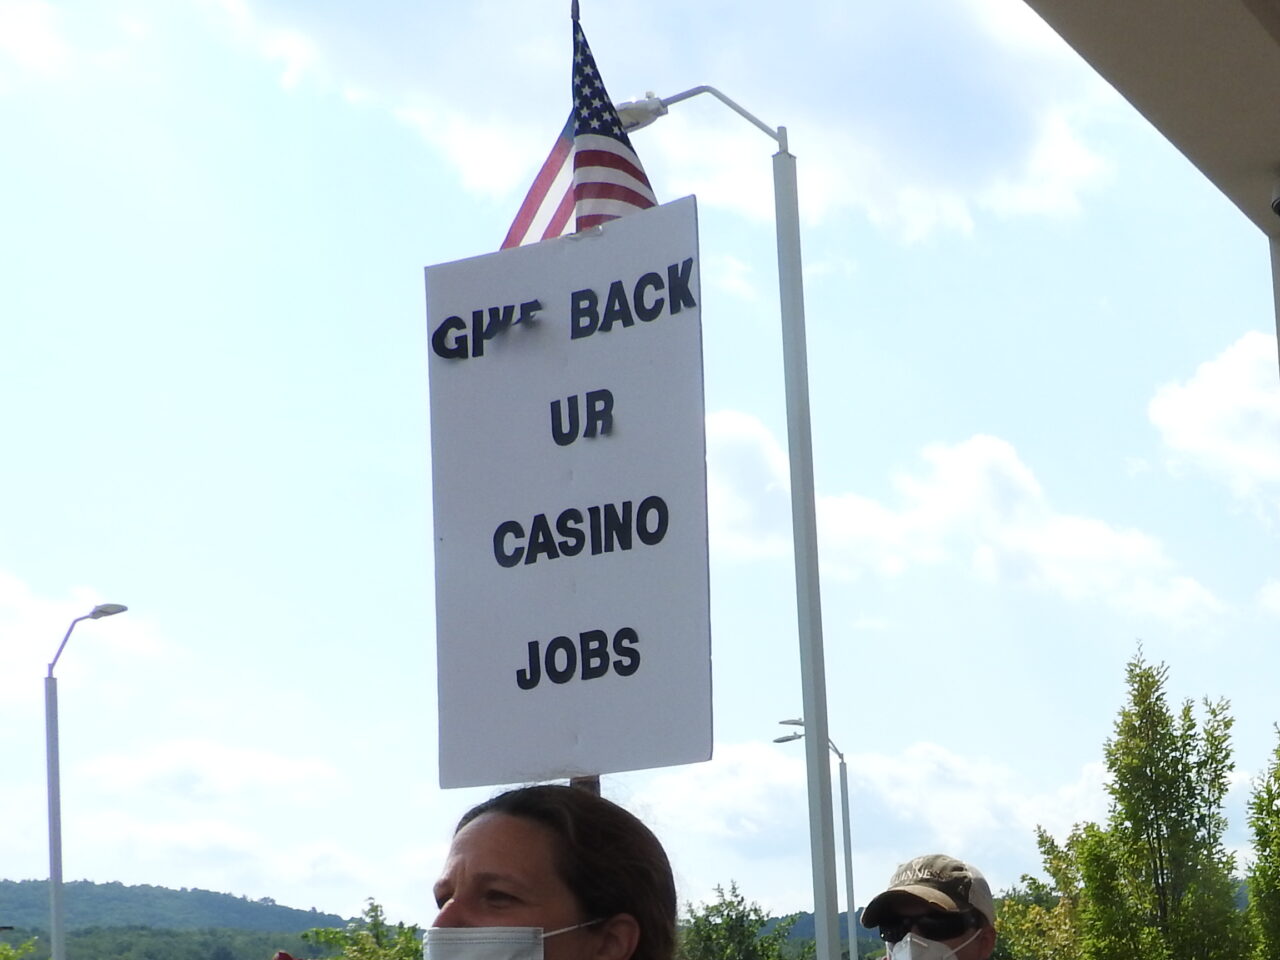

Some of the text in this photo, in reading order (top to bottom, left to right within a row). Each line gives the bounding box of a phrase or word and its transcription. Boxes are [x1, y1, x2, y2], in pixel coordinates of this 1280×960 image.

[569, 257, 698, 340] BACK
[550, 388, 614, 446] UR
[492, 495, 670, 569] CASINO
[515, 627, 641, 691] JOBS
